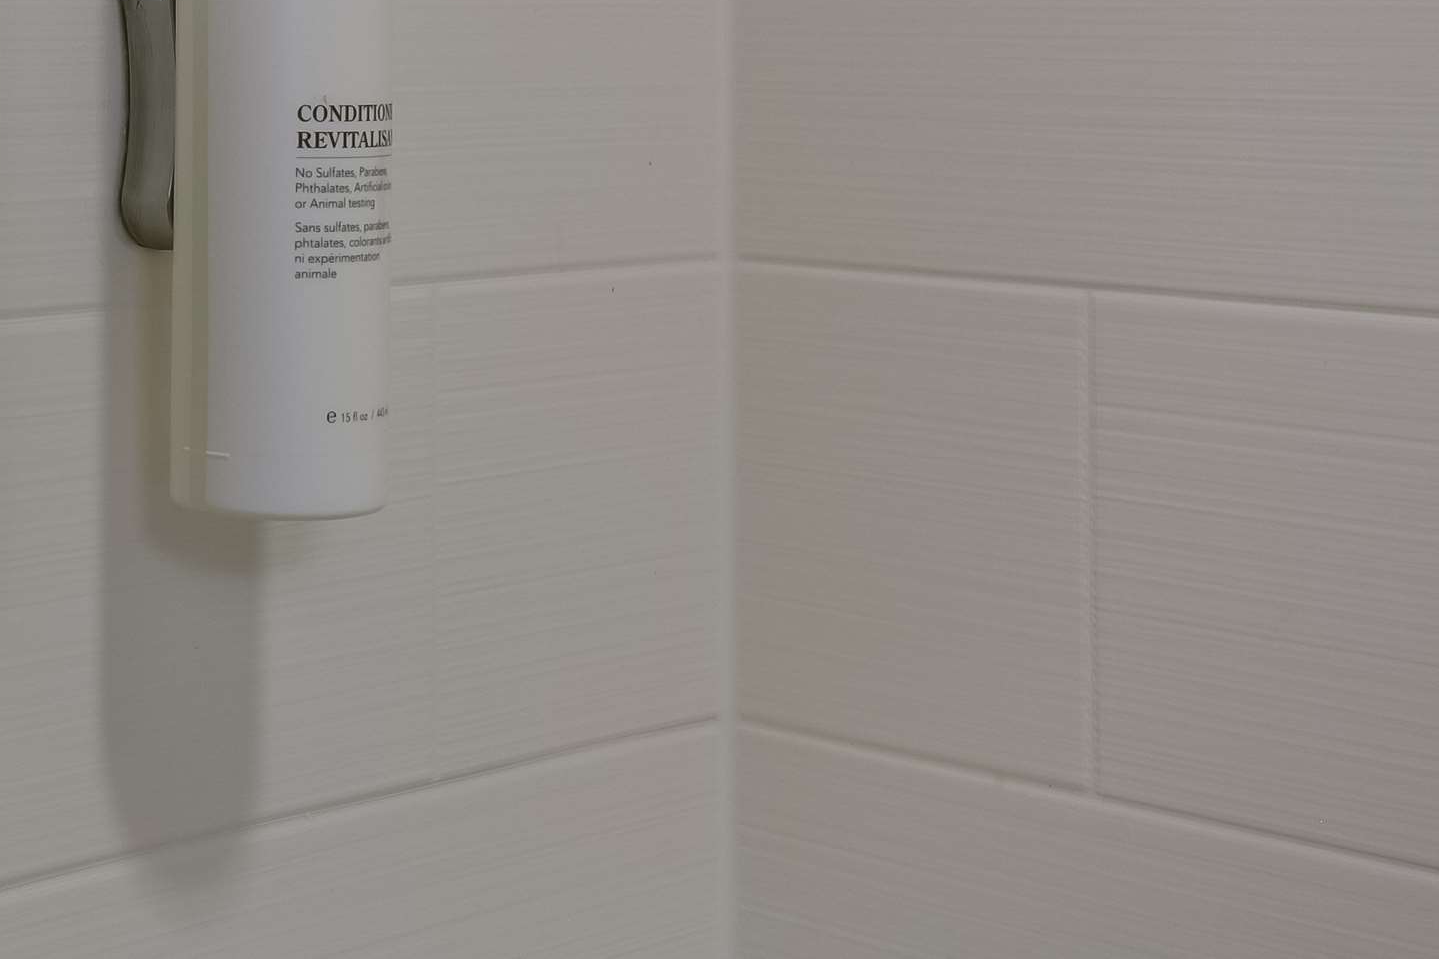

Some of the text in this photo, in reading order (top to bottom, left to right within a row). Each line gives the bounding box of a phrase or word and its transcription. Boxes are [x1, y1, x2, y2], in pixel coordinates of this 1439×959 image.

[295, 167, 312, 178] No
[316, 167, 357, 179] Sulfates,
[295, 182, 352, 195] Phthalates,
[295, 198, 375, 210] or Animal testing
[295, 222, 321, 233] Sans
[324, 222, 361, 234] sulfates,
[295, 237, 346, 251] phtalates,
[295, 254, 304, 263] ni
[295, 269, 337, 279] animale
[341, 412, 351, 423] 15
